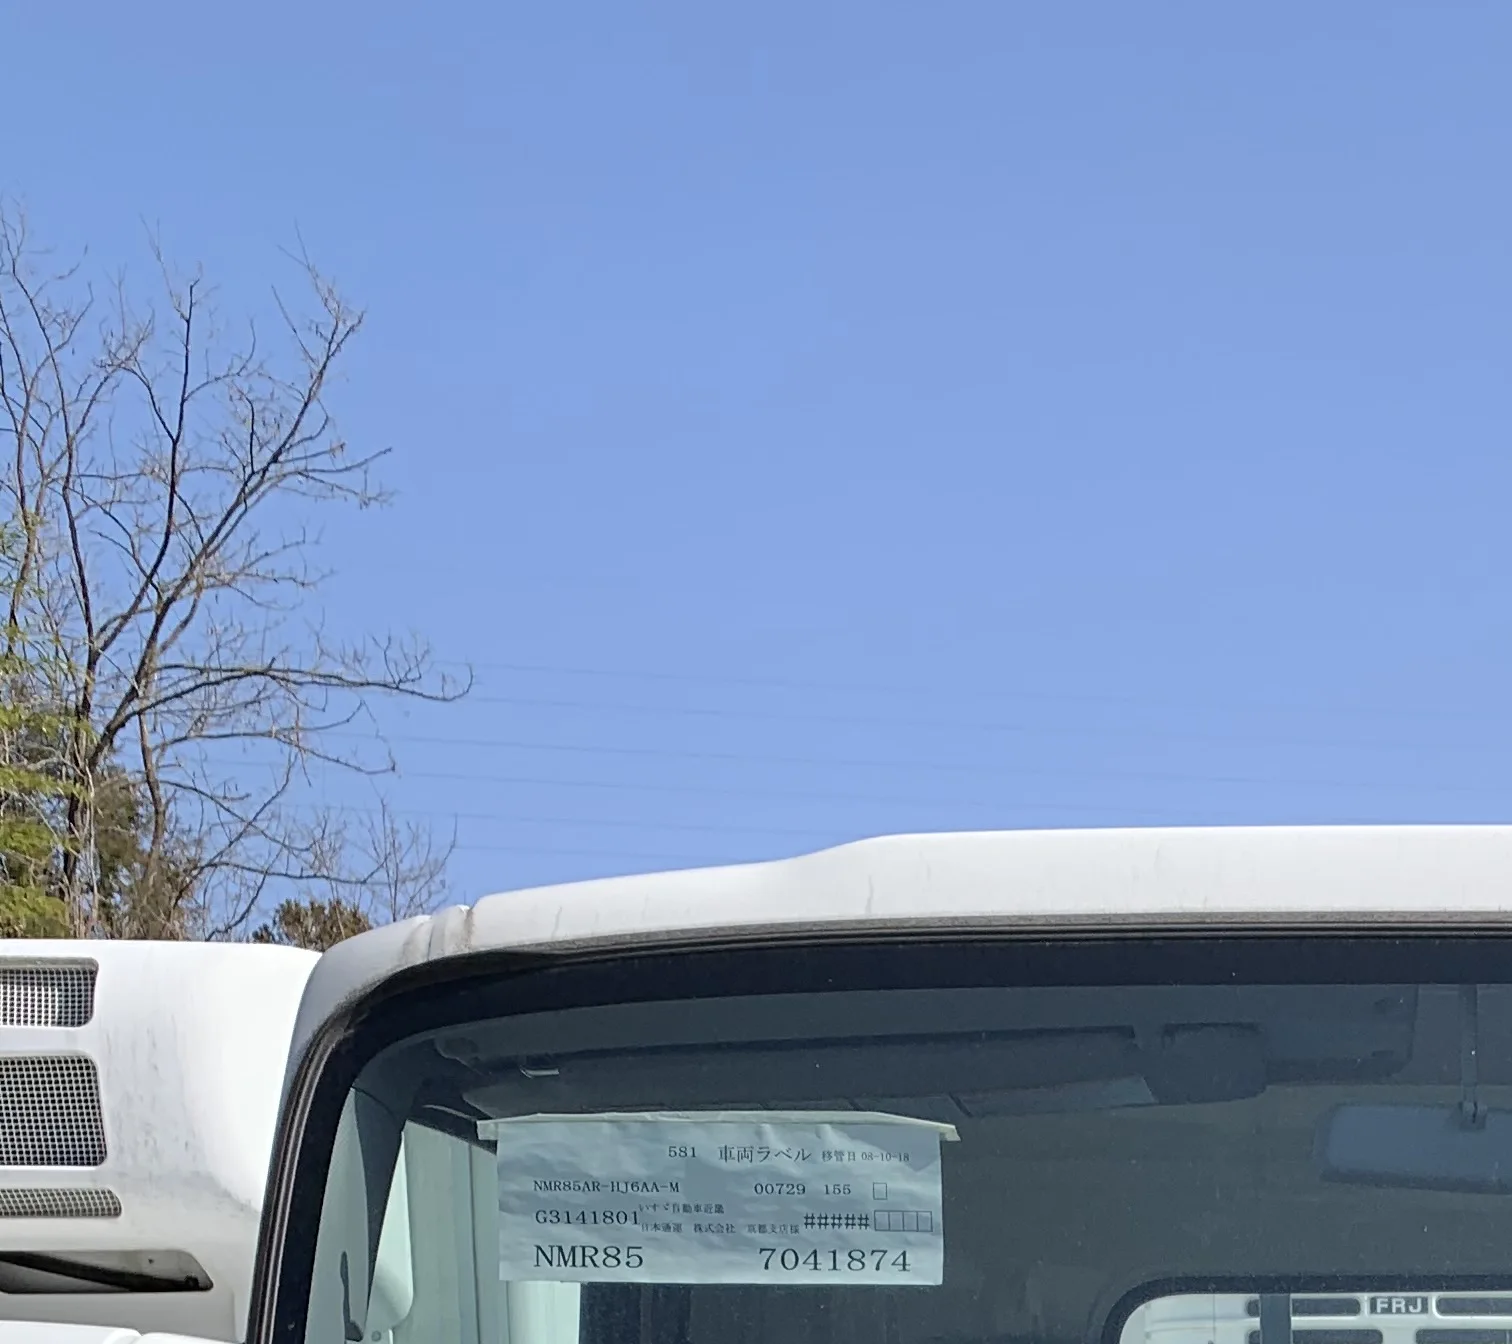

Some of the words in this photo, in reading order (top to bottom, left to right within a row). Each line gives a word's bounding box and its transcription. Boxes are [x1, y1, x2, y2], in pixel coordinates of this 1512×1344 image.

[668, 1146, 697, 1158] 581
[717, 1144, 812, 1164] 車両ラベル
[821, 1149, 856, 1162] 移管日
[533, 1179, 680, 1194] NMR85AR-HJ6AA-M
[754, 1182, 806, 1196] 00729
[823, 1183, 852, 1196] 155
[535, 1208, 640, 1226] G3141801
[641, 1222, 683, 1234] 日本通運
[693, 1222, 737, 1235] 株式会社
[534, 1243, 644, 1269] NMR85
[759, 1247, 911, 1273] 7041874
[1375, 1297, 1422, 1314] FRJ
